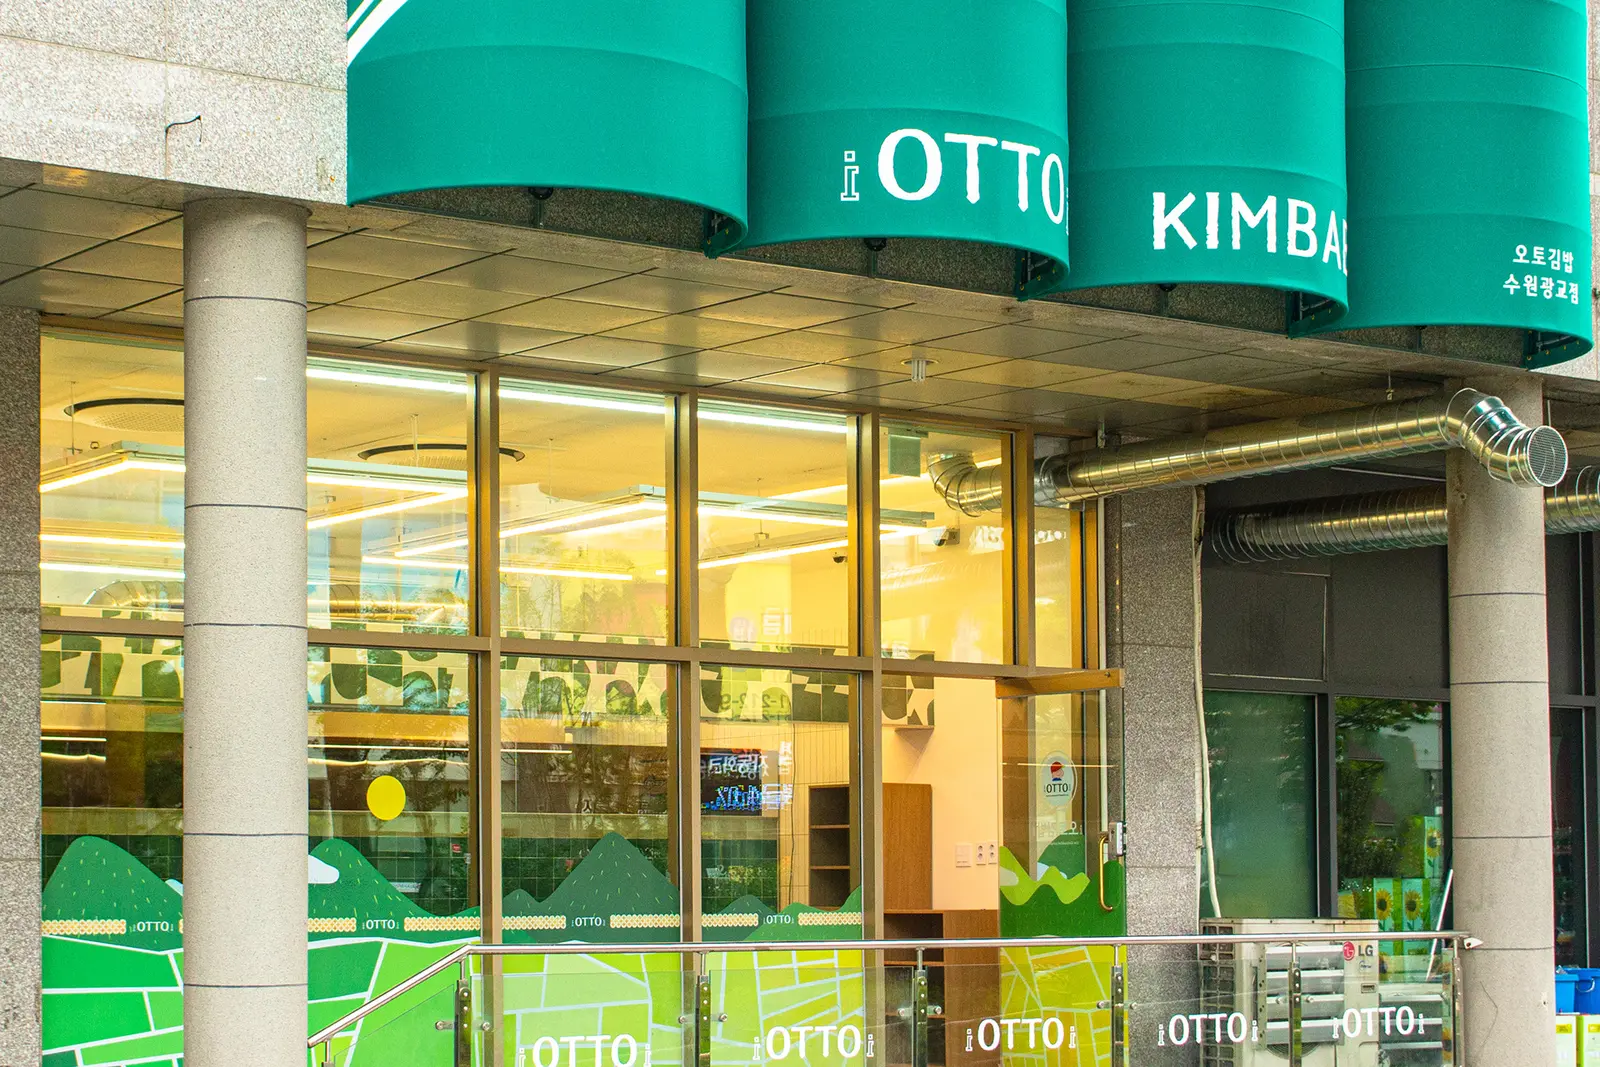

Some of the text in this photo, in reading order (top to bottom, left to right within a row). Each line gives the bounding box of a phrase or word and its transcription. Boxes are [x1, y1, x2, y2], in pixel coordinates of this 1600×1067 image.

[1512, 244, 1574, 274] 오토김밥
[1502, 273, 1579, 305] 수원광교점
[1358, 944, 1374, 957] LG
